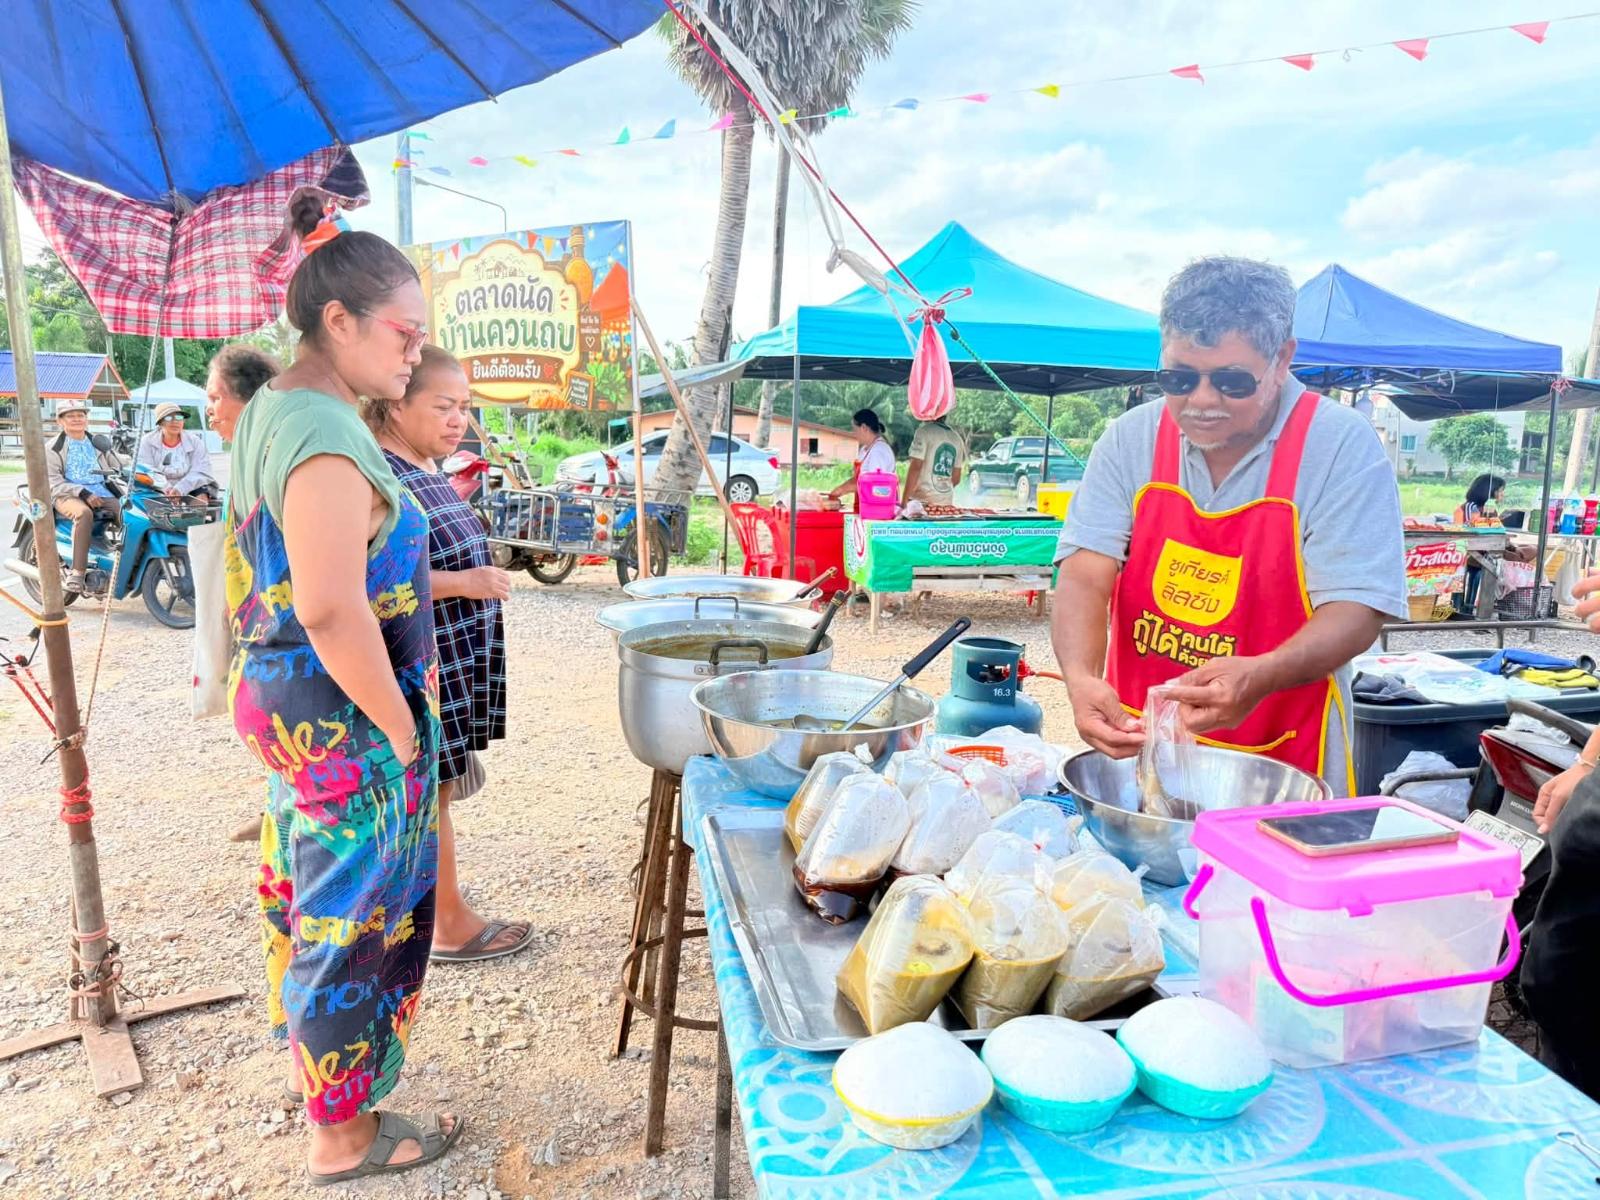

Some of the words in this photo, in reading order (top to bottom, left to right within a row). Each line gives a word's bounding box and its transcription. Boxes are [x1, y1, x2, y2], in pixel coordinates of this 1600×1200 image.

[456, 275, 553, 315] ตลาดนัด
[440, 313, 575, 352] บ้านควนถบ
[473, 357, 541, 379] ยินดีต้อนรับ
[931, 541, 1006, 557] จังหวัดพัทลุง
[1133, 609, 1183, 660] กู้ได้
[1181, 632, 1235, 657] คนใต้
[993, 687, 1011, 697] 16.3
